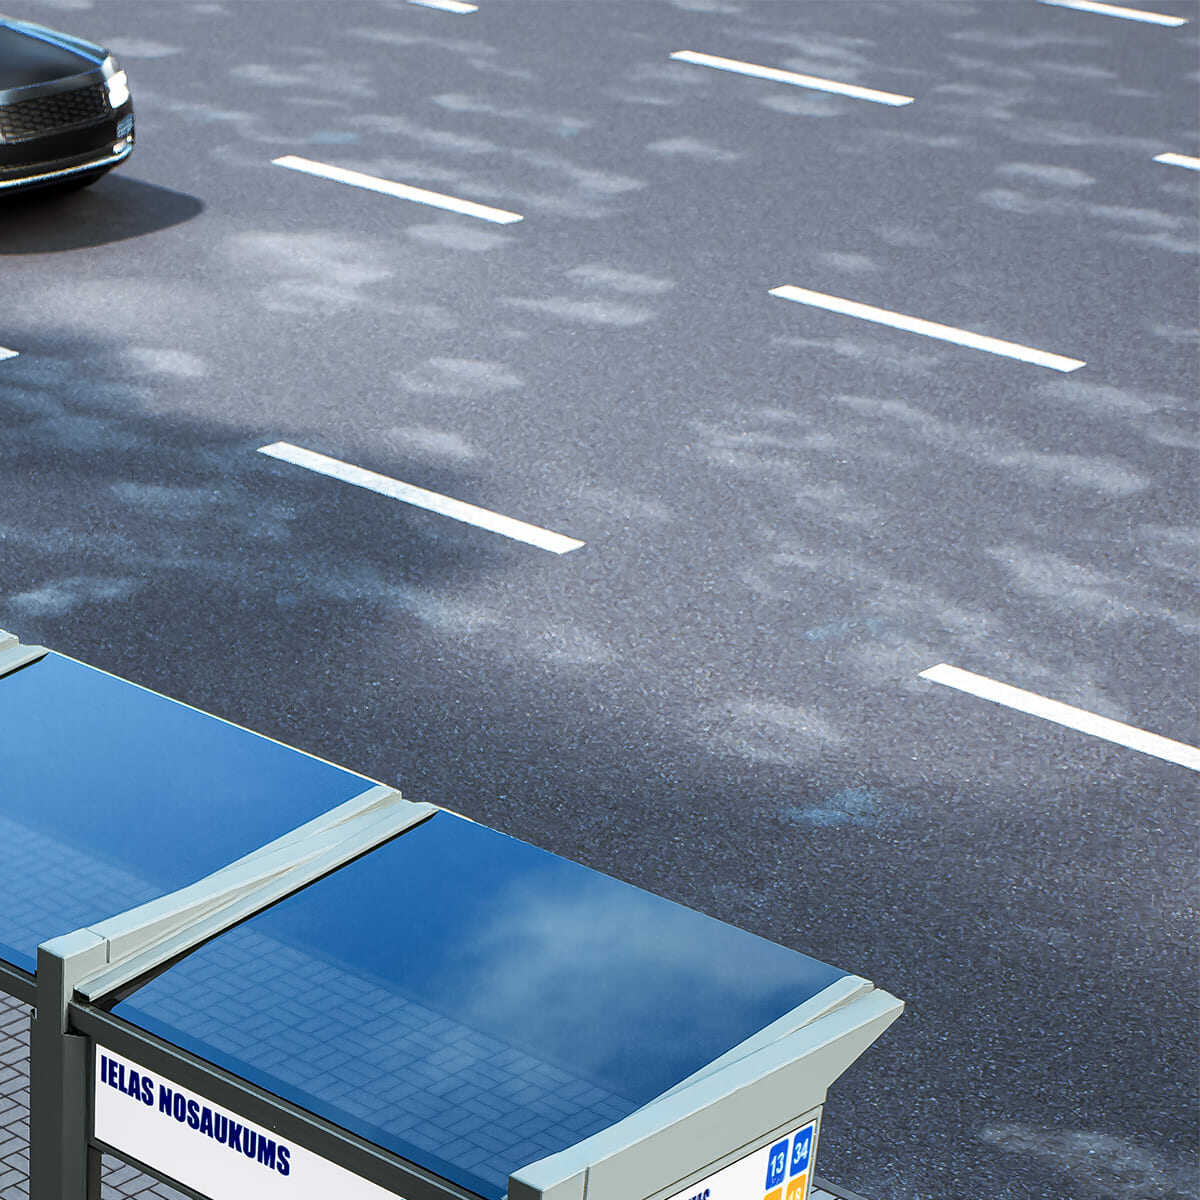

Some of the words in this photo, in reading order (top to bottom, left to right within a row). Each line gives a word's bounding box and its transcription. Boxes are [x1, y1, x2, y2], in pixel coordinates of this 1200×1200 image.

[101, 1054, 154, 1106] IELAS
[158, 1084, 291, 1176] NOSAUKUMS
[770, 1152, 785, 1177] 13
[793, 1139, 808, 1164] 34
